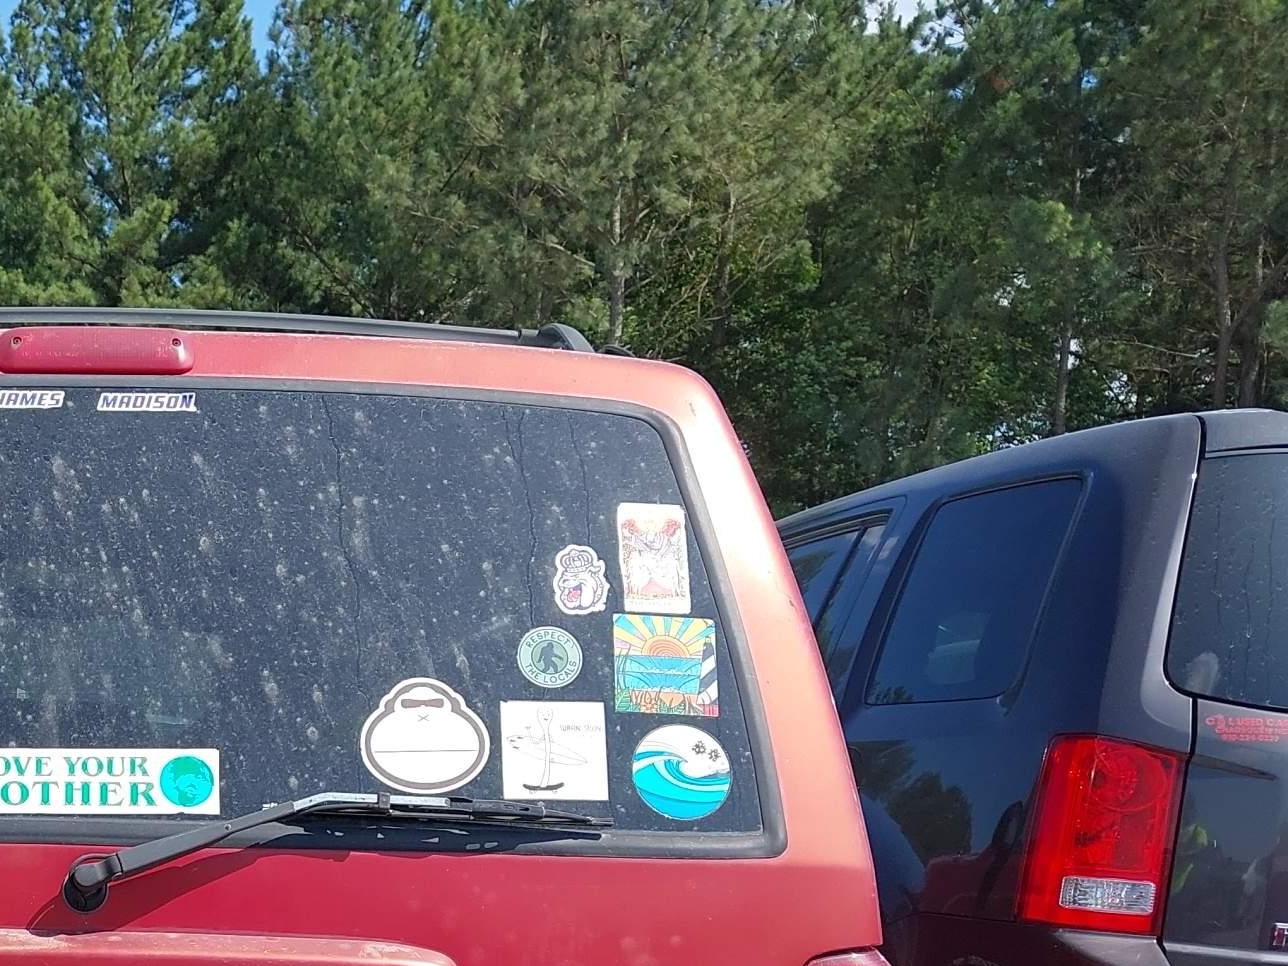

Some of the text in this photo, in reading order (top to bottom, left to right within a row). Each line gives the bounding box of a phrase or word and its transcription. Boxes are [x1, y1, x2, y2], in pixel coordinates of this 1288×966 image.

[100, 393, 194, 409] MADISON
[525, 630, 571, 648] RESPECT
[525, 660, 577, 684] THE LOCALS
[63, 756, 150, 778] YOUR
